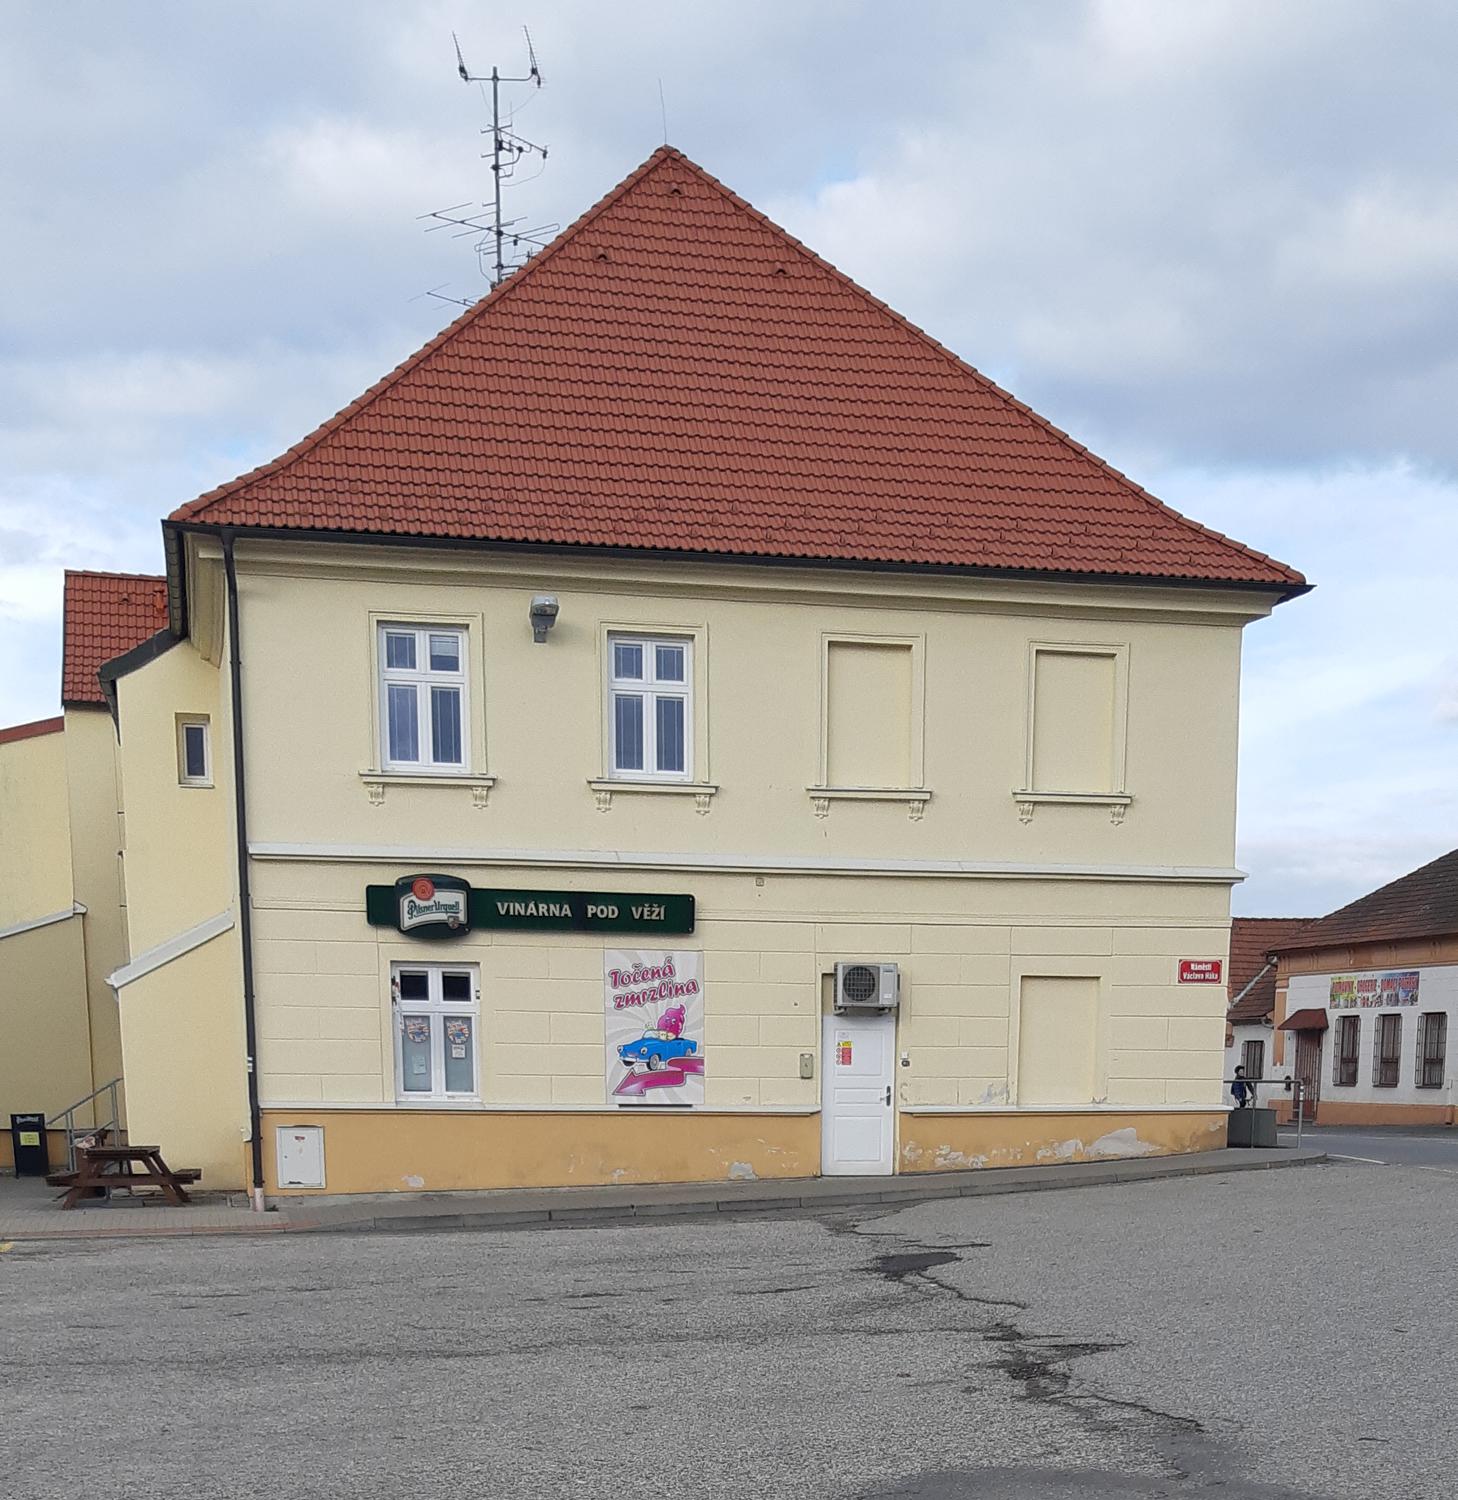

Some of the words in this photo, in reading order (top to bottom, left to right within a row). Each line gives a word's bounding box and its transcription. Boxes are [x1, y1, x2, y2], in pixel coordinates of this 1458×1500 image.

[407, 899, 433, 920] Pilsner
[496, 901, 572, 918] VINÁRNA
[586, 904, 619, 919] POD
[631, 903, 666, 921] VĚŽÍ
[609, 956, 676, 989] Točená
[613, 979, 700, 1010] zmrzlina
